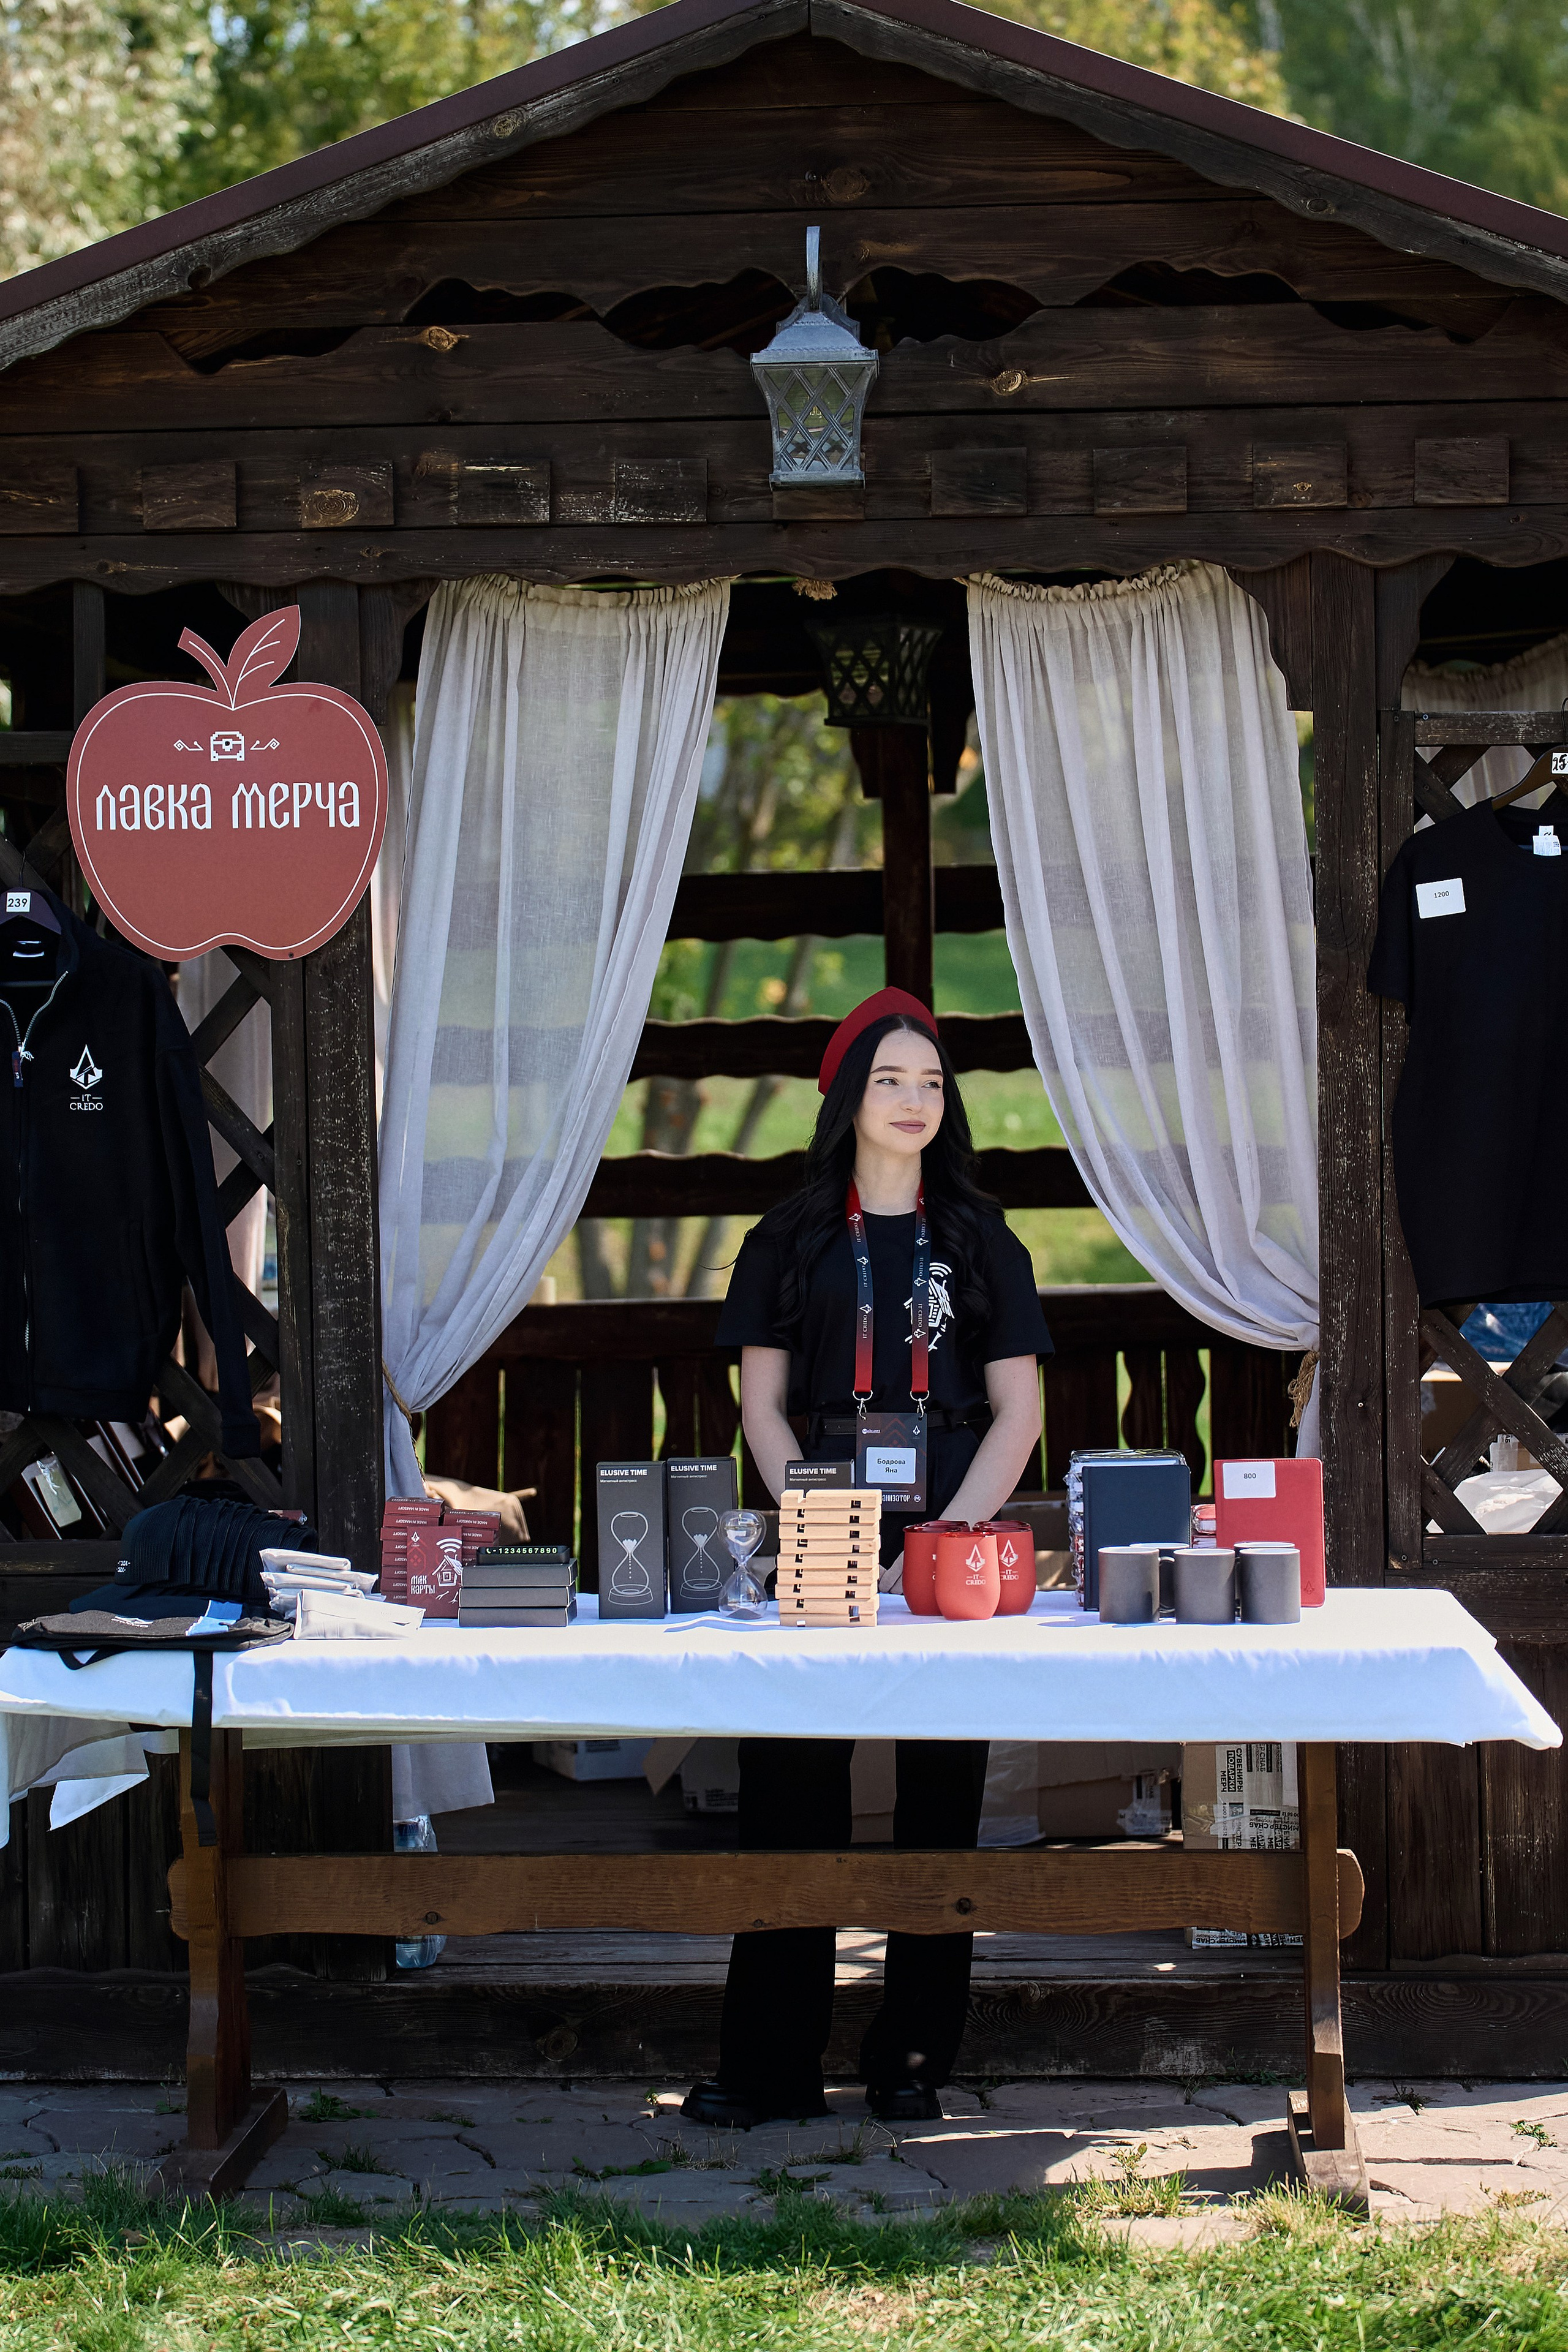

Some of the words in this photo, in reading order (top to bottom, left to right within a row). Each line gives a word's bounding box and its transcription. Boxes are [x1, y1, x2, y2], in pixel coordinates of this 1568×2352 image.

[1552, 753, 1568, 771] 25
[7, 898, 28, 907] 239
[1227, 1752, 1236, 1791] ПОДАРКИ
